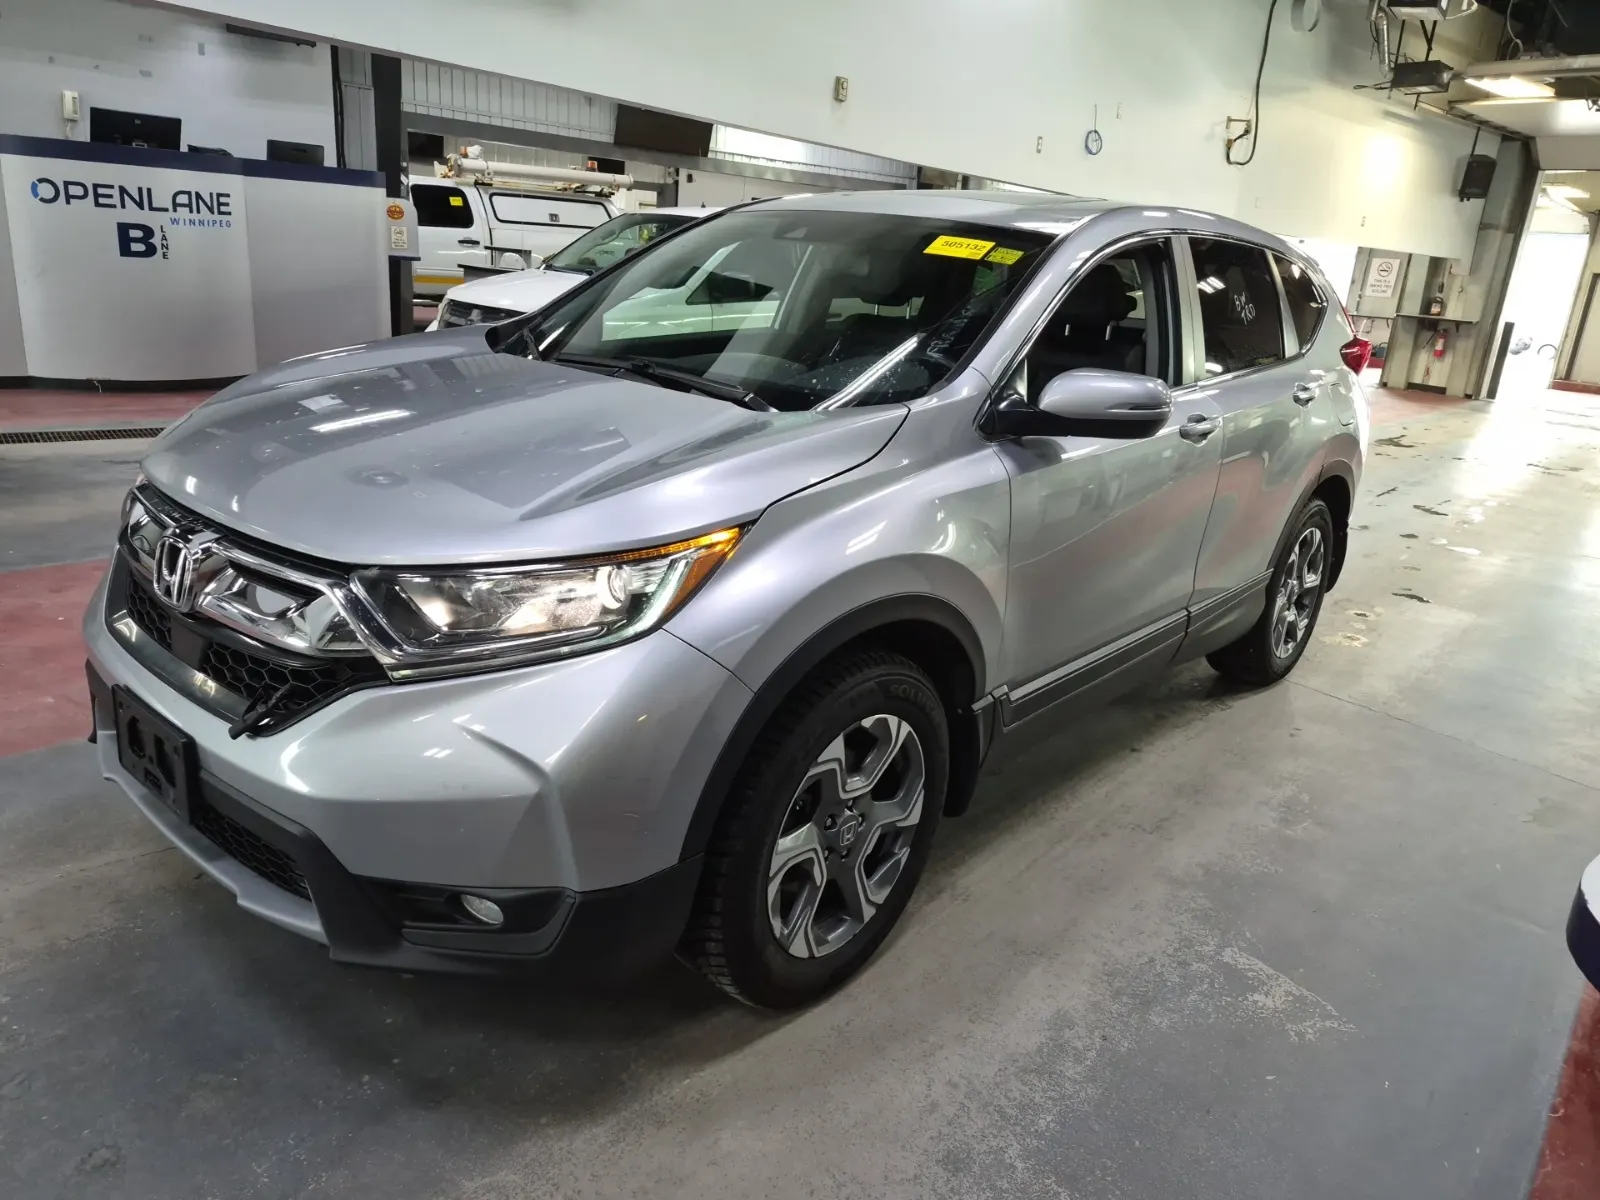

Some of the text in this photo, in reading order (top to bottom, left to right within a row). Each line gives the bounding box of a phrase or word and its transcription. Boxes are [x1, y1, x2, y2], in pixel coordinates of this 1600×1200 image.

[31, 177, 232, 216] OPENLANE
[169, 217, 232, 228] WINNIPEG
[116, 222, 158, 259] B
[160, 225, 169, 260] LANE
[941, 240, 986, 251] 505132
